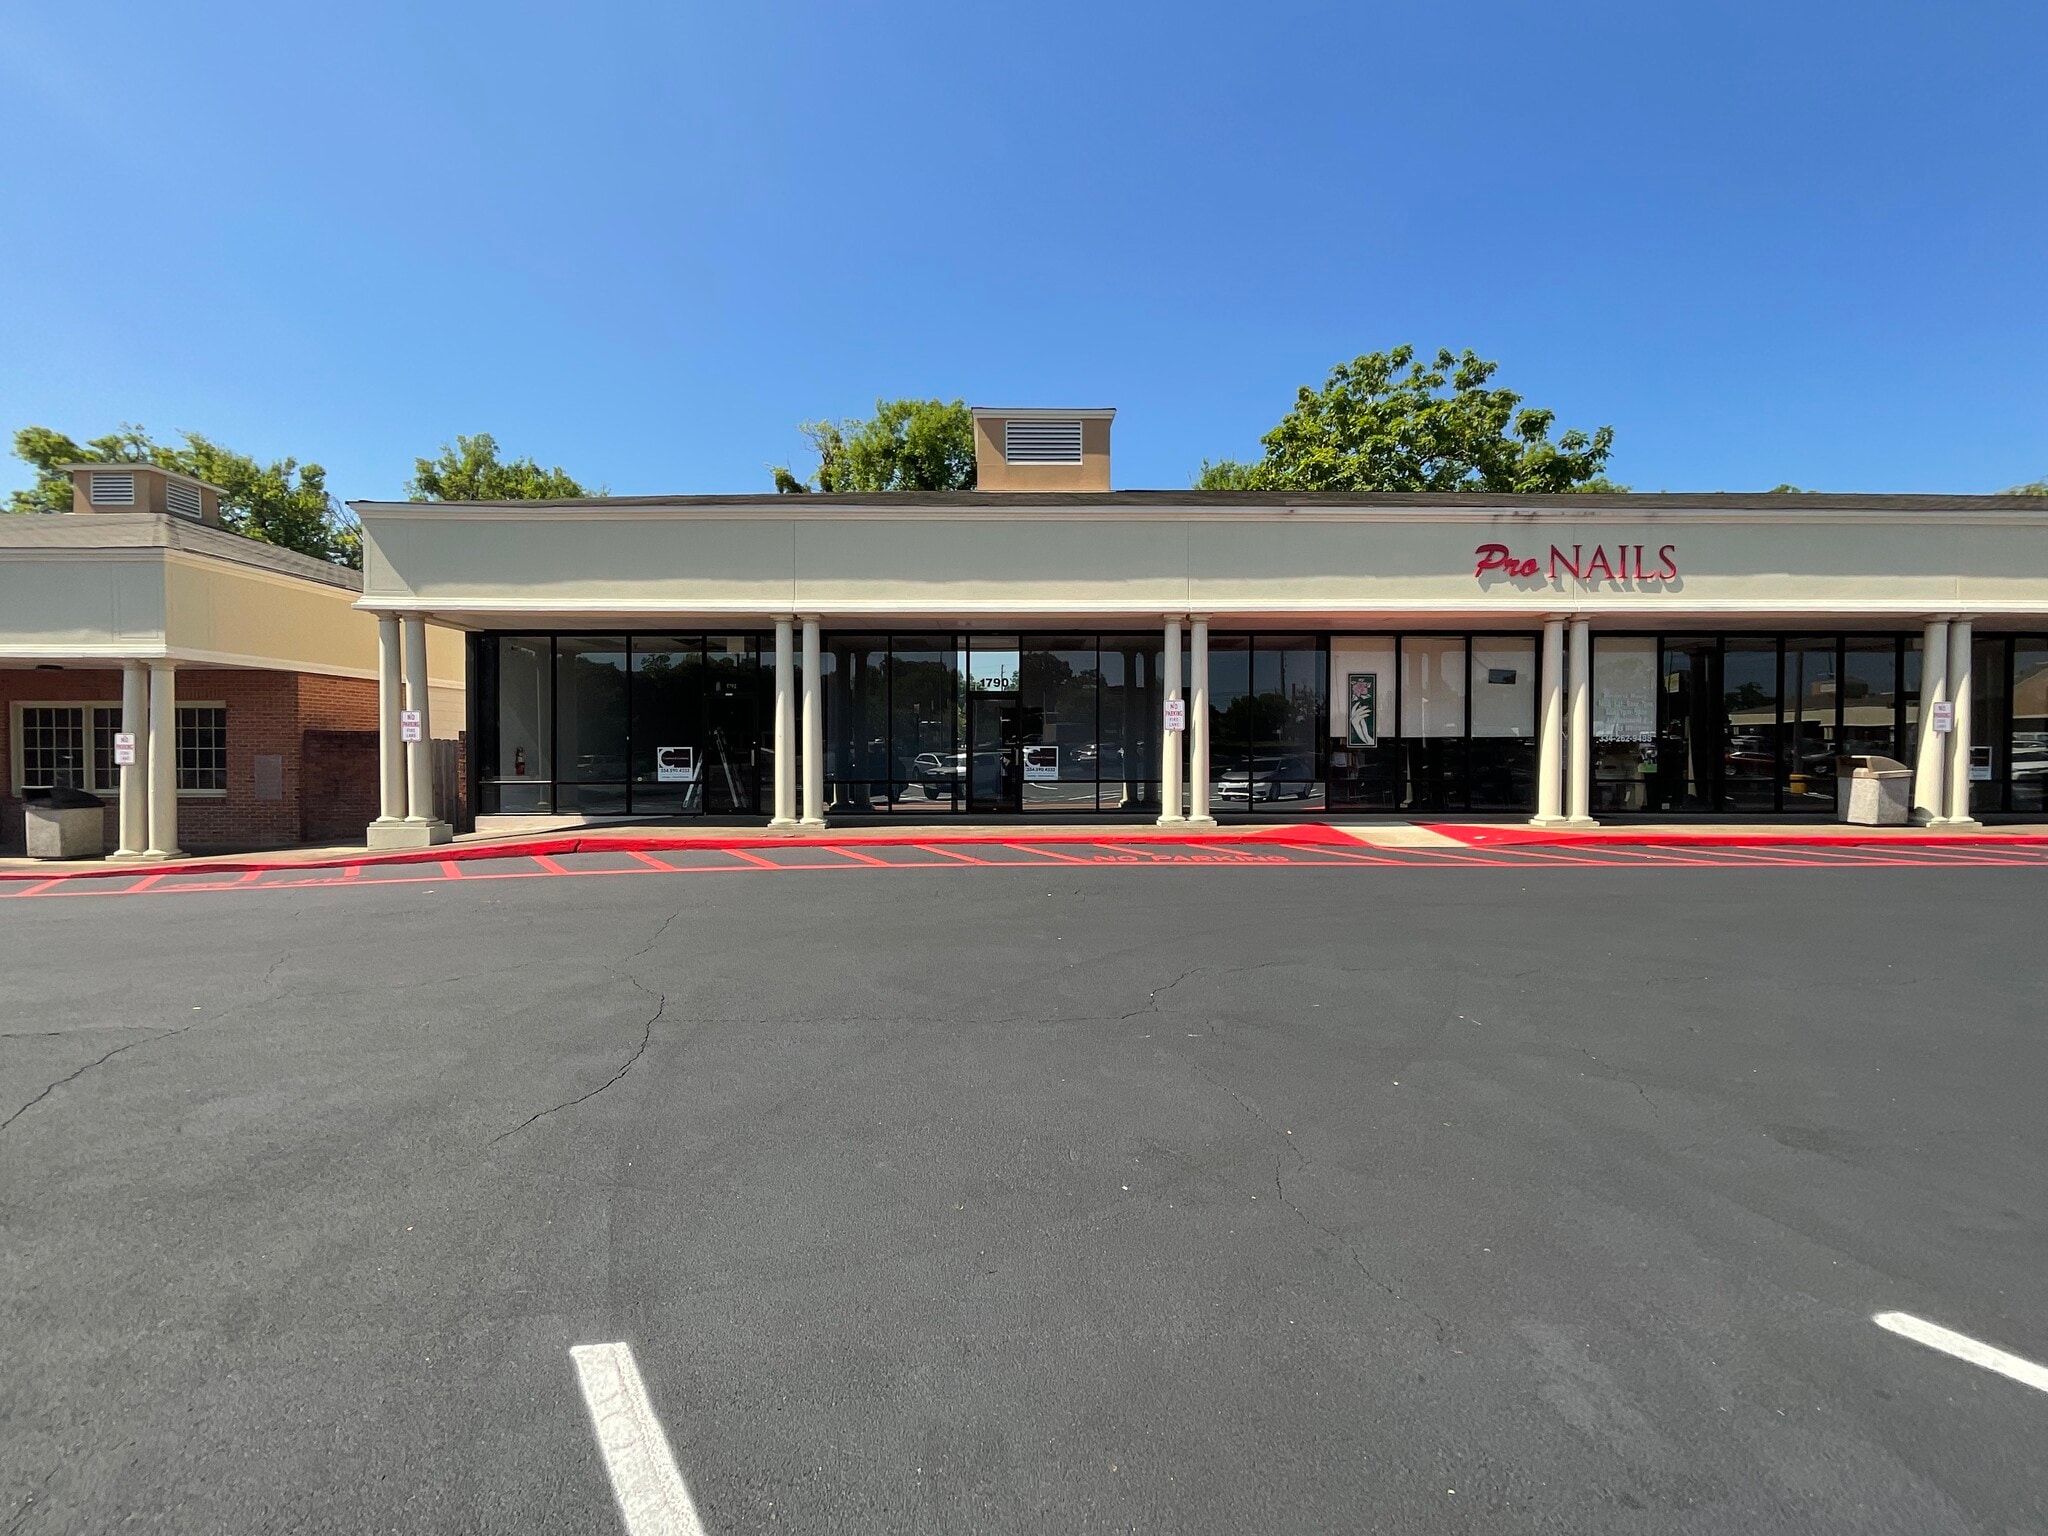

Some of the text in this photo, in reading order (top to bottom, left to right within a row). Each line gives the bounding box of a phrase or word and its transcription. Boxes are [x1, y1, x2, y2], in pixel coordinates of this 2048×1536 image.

[1475, 543, 1677, 579] Pro NAILS
[981, 678, 1009, 688] 1790
[1093, 853, 1290, 862] NO PARKING
